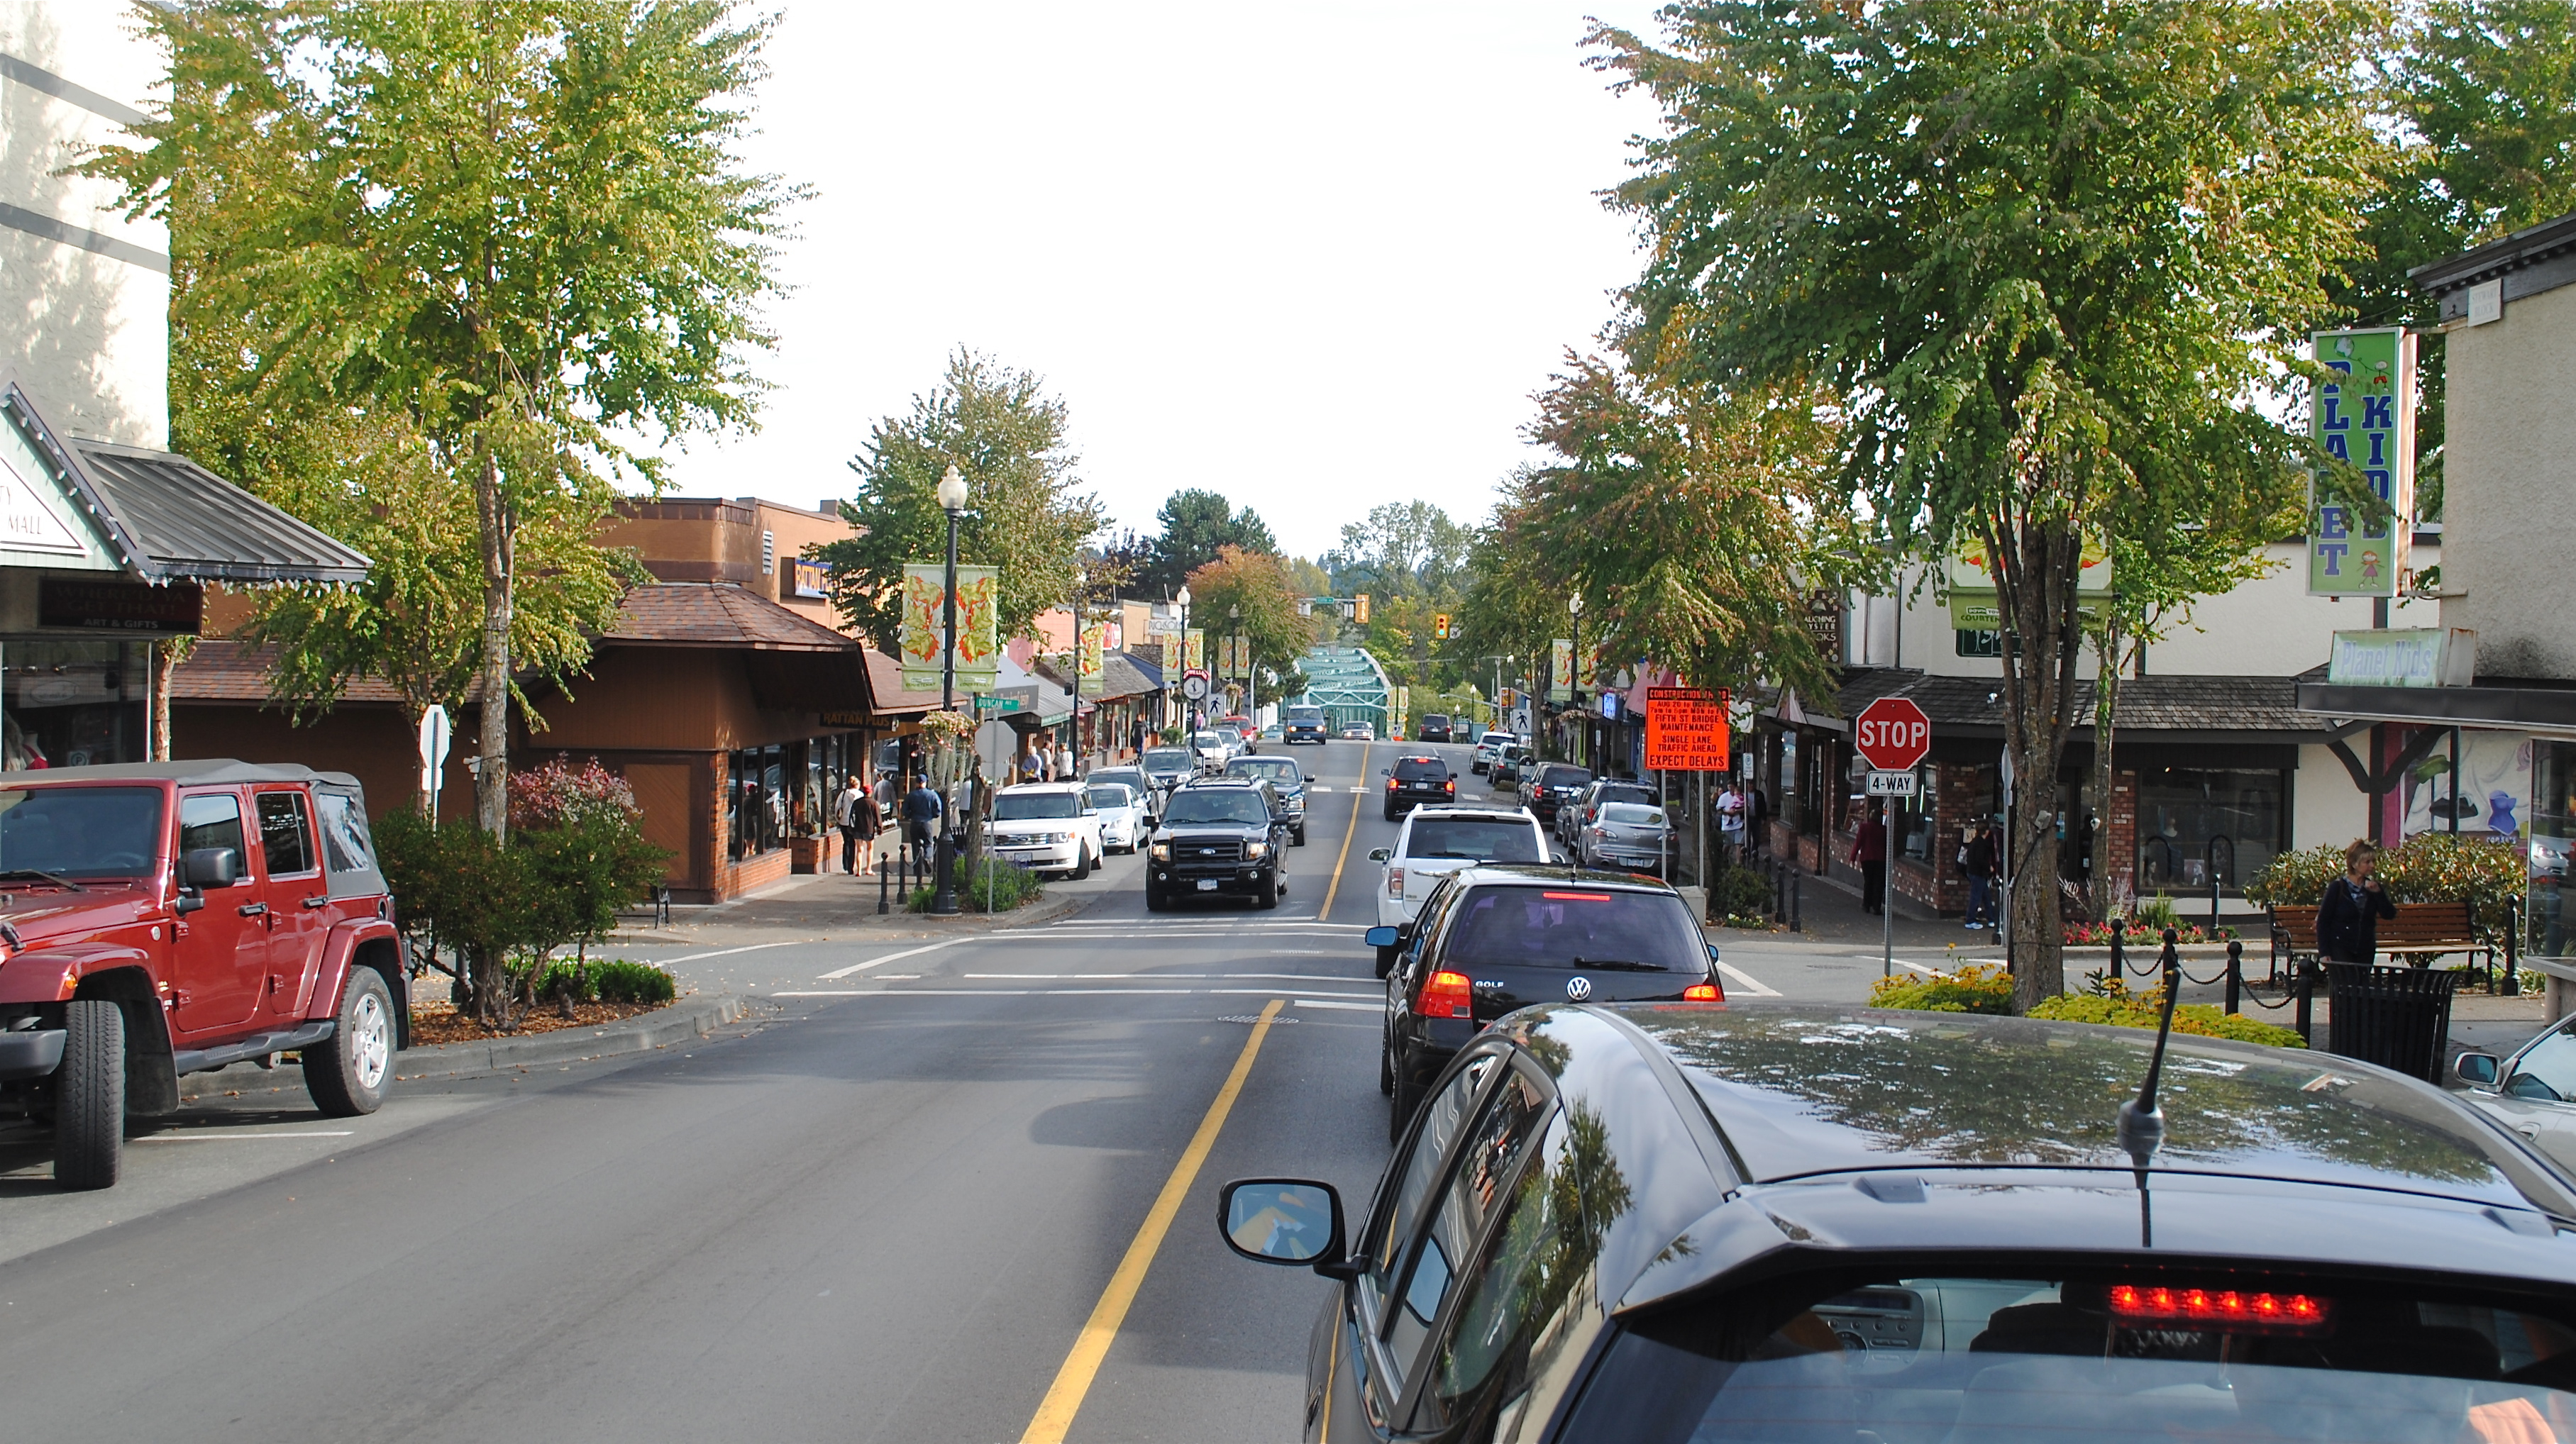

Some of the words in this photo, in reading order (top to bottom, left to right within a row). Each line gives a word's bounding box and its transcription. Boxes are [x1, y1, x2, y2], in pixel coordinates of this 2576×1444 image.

[2475, 304, 2494, 317] BLOCK
[2317, 360, 2351, 577] PLAET
[8, 514, 42, 535] MALL
[162, 590, 186, 603] YA
[67, 599, 108, 613] GET
[116, 601, 176, 616] THAT!
[84, 618, 107, 627] ART
[111, 619, 121, 628] &
[124, 619, 159, 629] GIFTS
[1816, 633, 1837, 642] OKS
[2340, 640, 2389, 677] Planet
[2393, 640, 2432, 677] Kids
[1649, 689, 1701, 699] CONSTRUCTION
[979, 698, 1003, 709] DUNCAN
[824, 712, 863, 726] RATTAN
[866, 714, 890, 727] PLUS
[1679, 714, 1689, 723] ST
[1692, 714, 1719, 723] BRIDGE
[1660, 723, 1714, 732] MAINTENANCE
[1662, 735, 1689, 743] SINGLE
[1692, 735, 1712, 744] LANE
[1860, 720, 1926, 748] STOP
[1657, 743, 1688, 752] TRAFFIC
[1691, 744, 1717, 752] AHEAD
[1649, 755, 1685, 766] EXPECT
[1688, 755, 1725, 767] DELAYS
[1872, 777, 1911, 791] 4-WAY
[1476, 980, 1504, 989] GOLF
